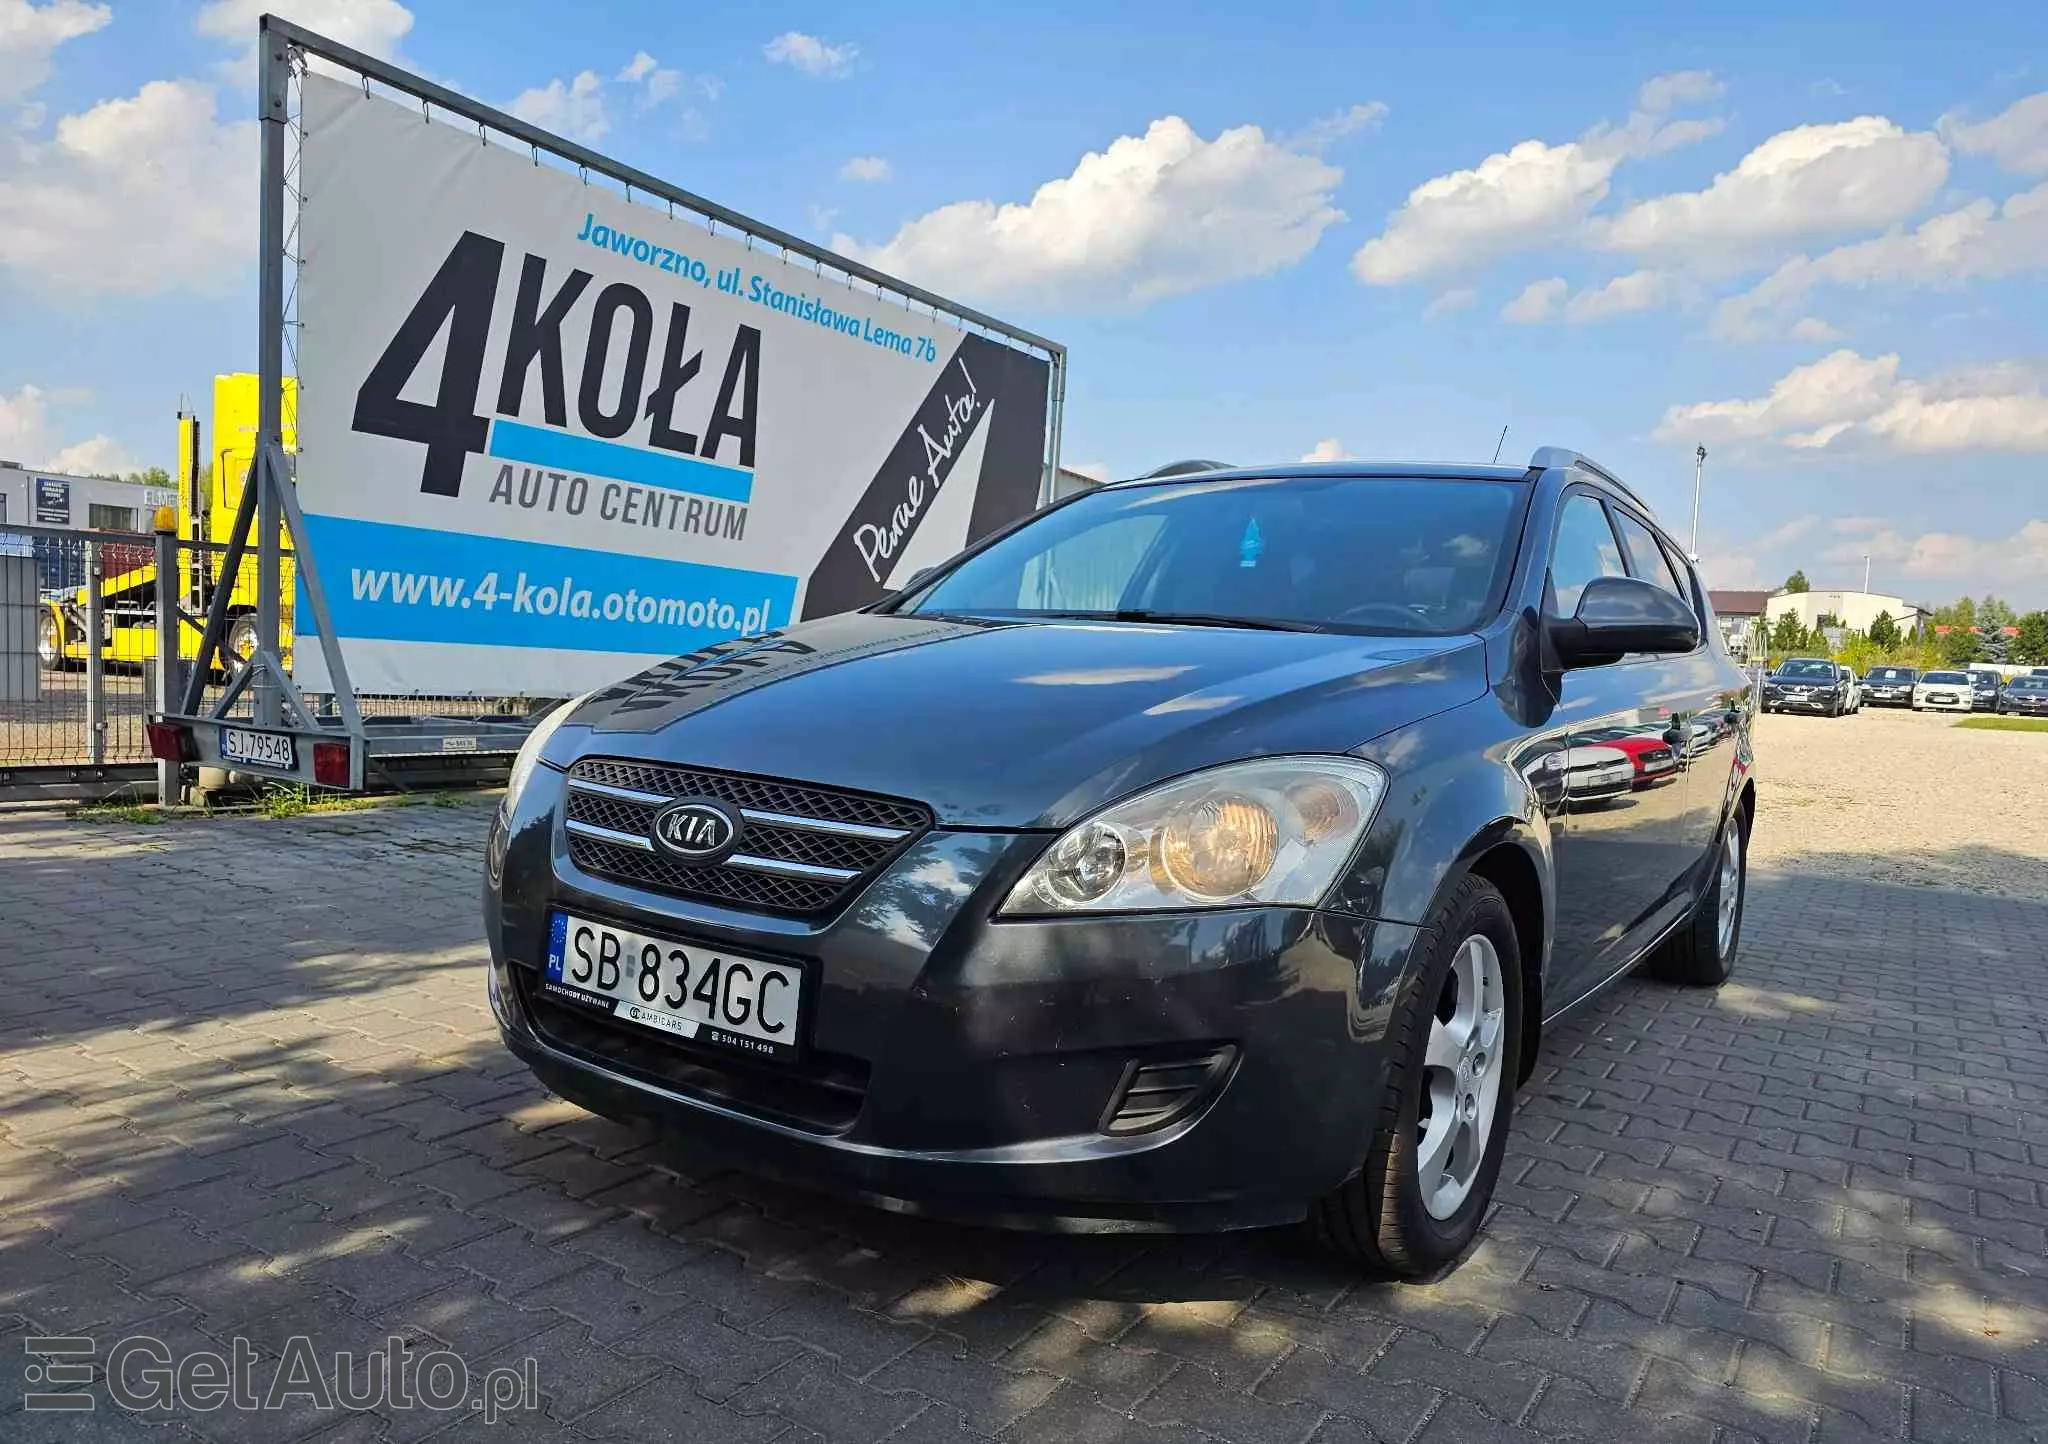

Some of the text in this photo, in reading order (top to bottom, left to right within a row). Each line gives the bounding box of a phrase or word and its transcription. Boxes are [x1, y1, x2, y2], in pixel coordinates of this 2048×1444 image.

[577, 213, 936, 363] Jaworzno, ul. Stanisława Lema 7b
[917, 357, 982, 489] Auta!
[489, 464, 748, 541] AUTO CENTRUM
[351, 569, 772, 637] www.4-kola.otomoto.pl
[249, 734, 290, 761] 79548
[666, 813, 716, 847] KIA
[549, 953, 562, 972] PL
[571, 926, 790, 1034] SB 834GC
[722, 1034, 737, 1046] 504
